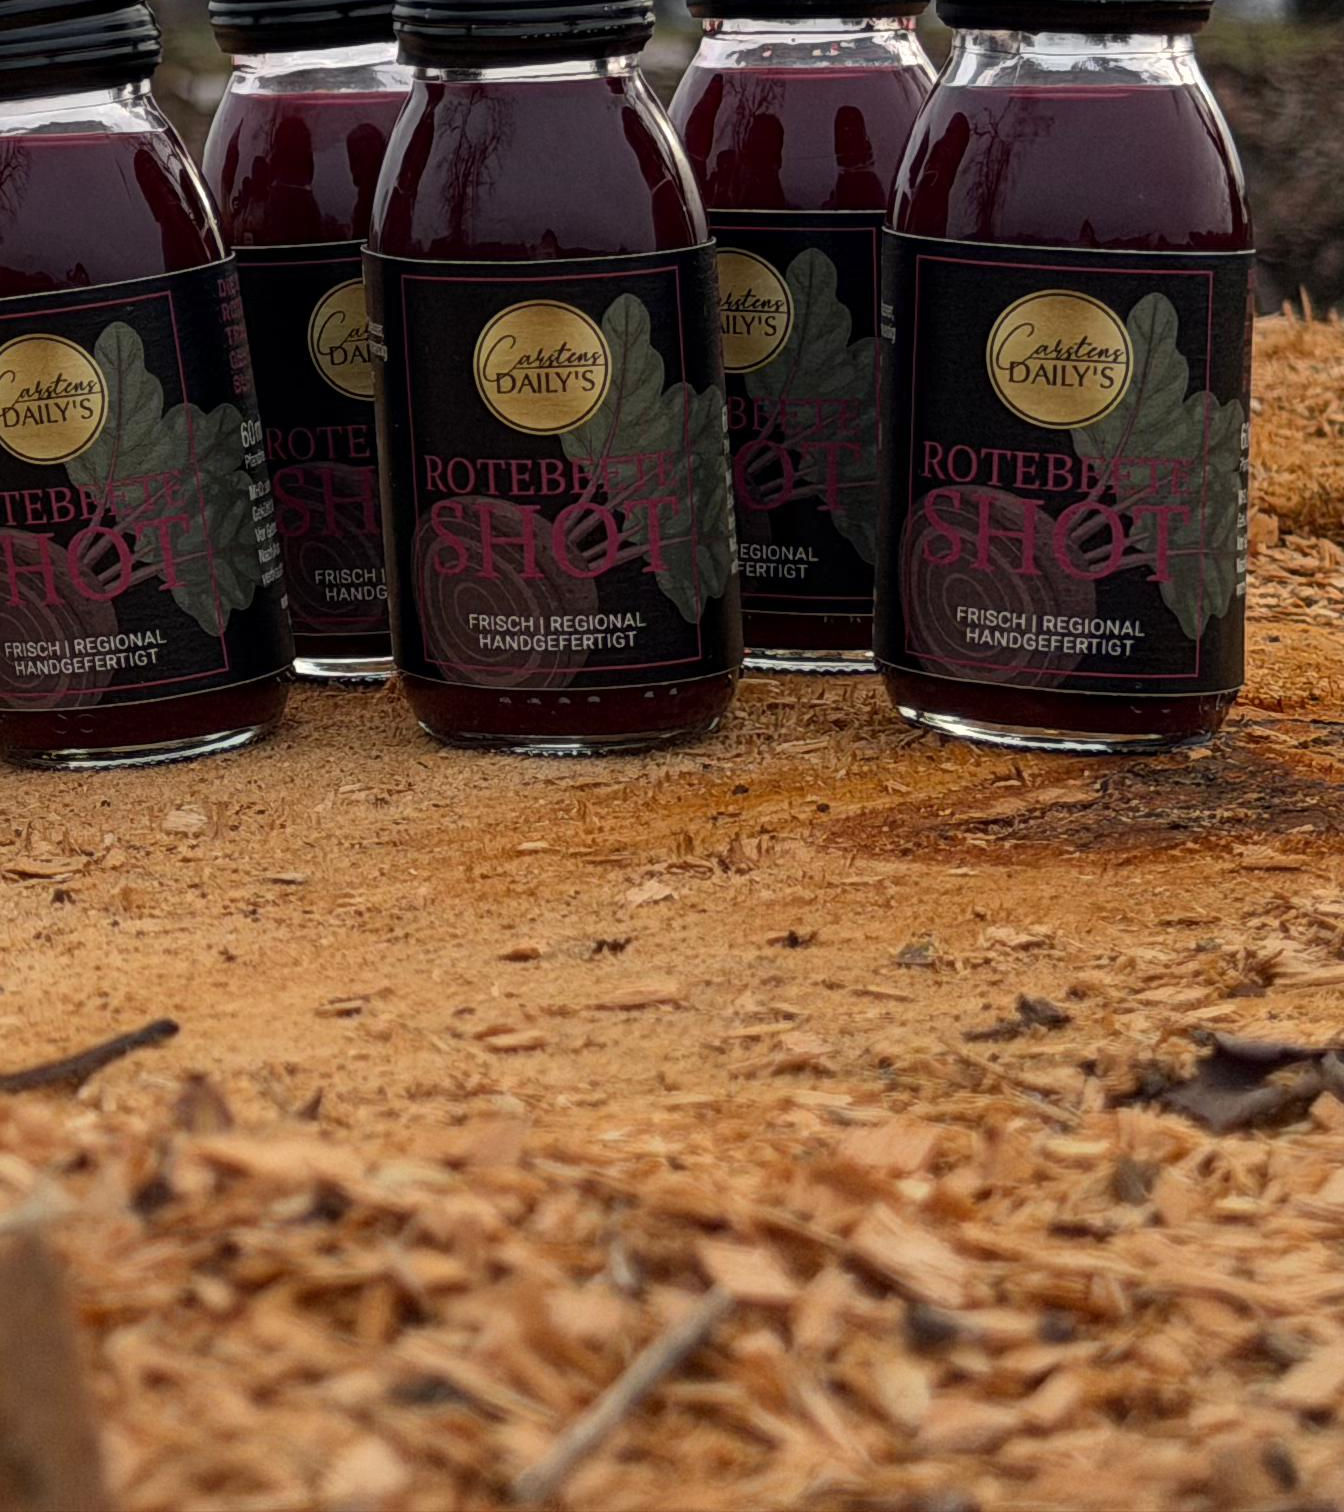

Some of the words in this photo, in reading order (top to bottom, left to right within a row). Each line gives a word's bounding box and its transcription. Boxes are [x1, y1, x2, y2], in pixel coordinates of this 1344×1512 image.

[329, 343, 371, 366] DAI
[482, 334, 604, 383] Carstens
[996, 323, 1125, 372] Carstens
[495, 369, 597, 395] DAILY'S
[1008, 361, 1116, 389] DAILY'S
[2, 397, 95, 429] DAILY'S
[727, 396, 861, 434] BEETE
[241, 419, 255, 448] 60
[424, 451, 677, 497] ROTEBEETE
[734, 440, 863, 513] OT
[922, 440, 1196, 498] ROTEBEETE
[272, 465, 381, 537] SH
[430, 495, 681, 580] SHOT
[921, 488, 1192, 583] SHOT
[740, 544, 820, 562] EGIONAL
[315, 568, 376, 585] FRISCH
[468, 613, 534, 633] FRISCH
[550, 612, 647, 632] REGIONAL
[956, 606, 1026, 630] FRISCH
[1043, 614, 1145, 638] REGIONAL
[4, 639, 59, 659] FRISCH
[75, 629, 168, 655] REGIONAL
[479, 631, 638, 651] HANDGEFERTIGT
[965, 627, 1135, 657] HANDGEFERTIGT
[15, 648, 159, 676] HANDGEFERTIGT
